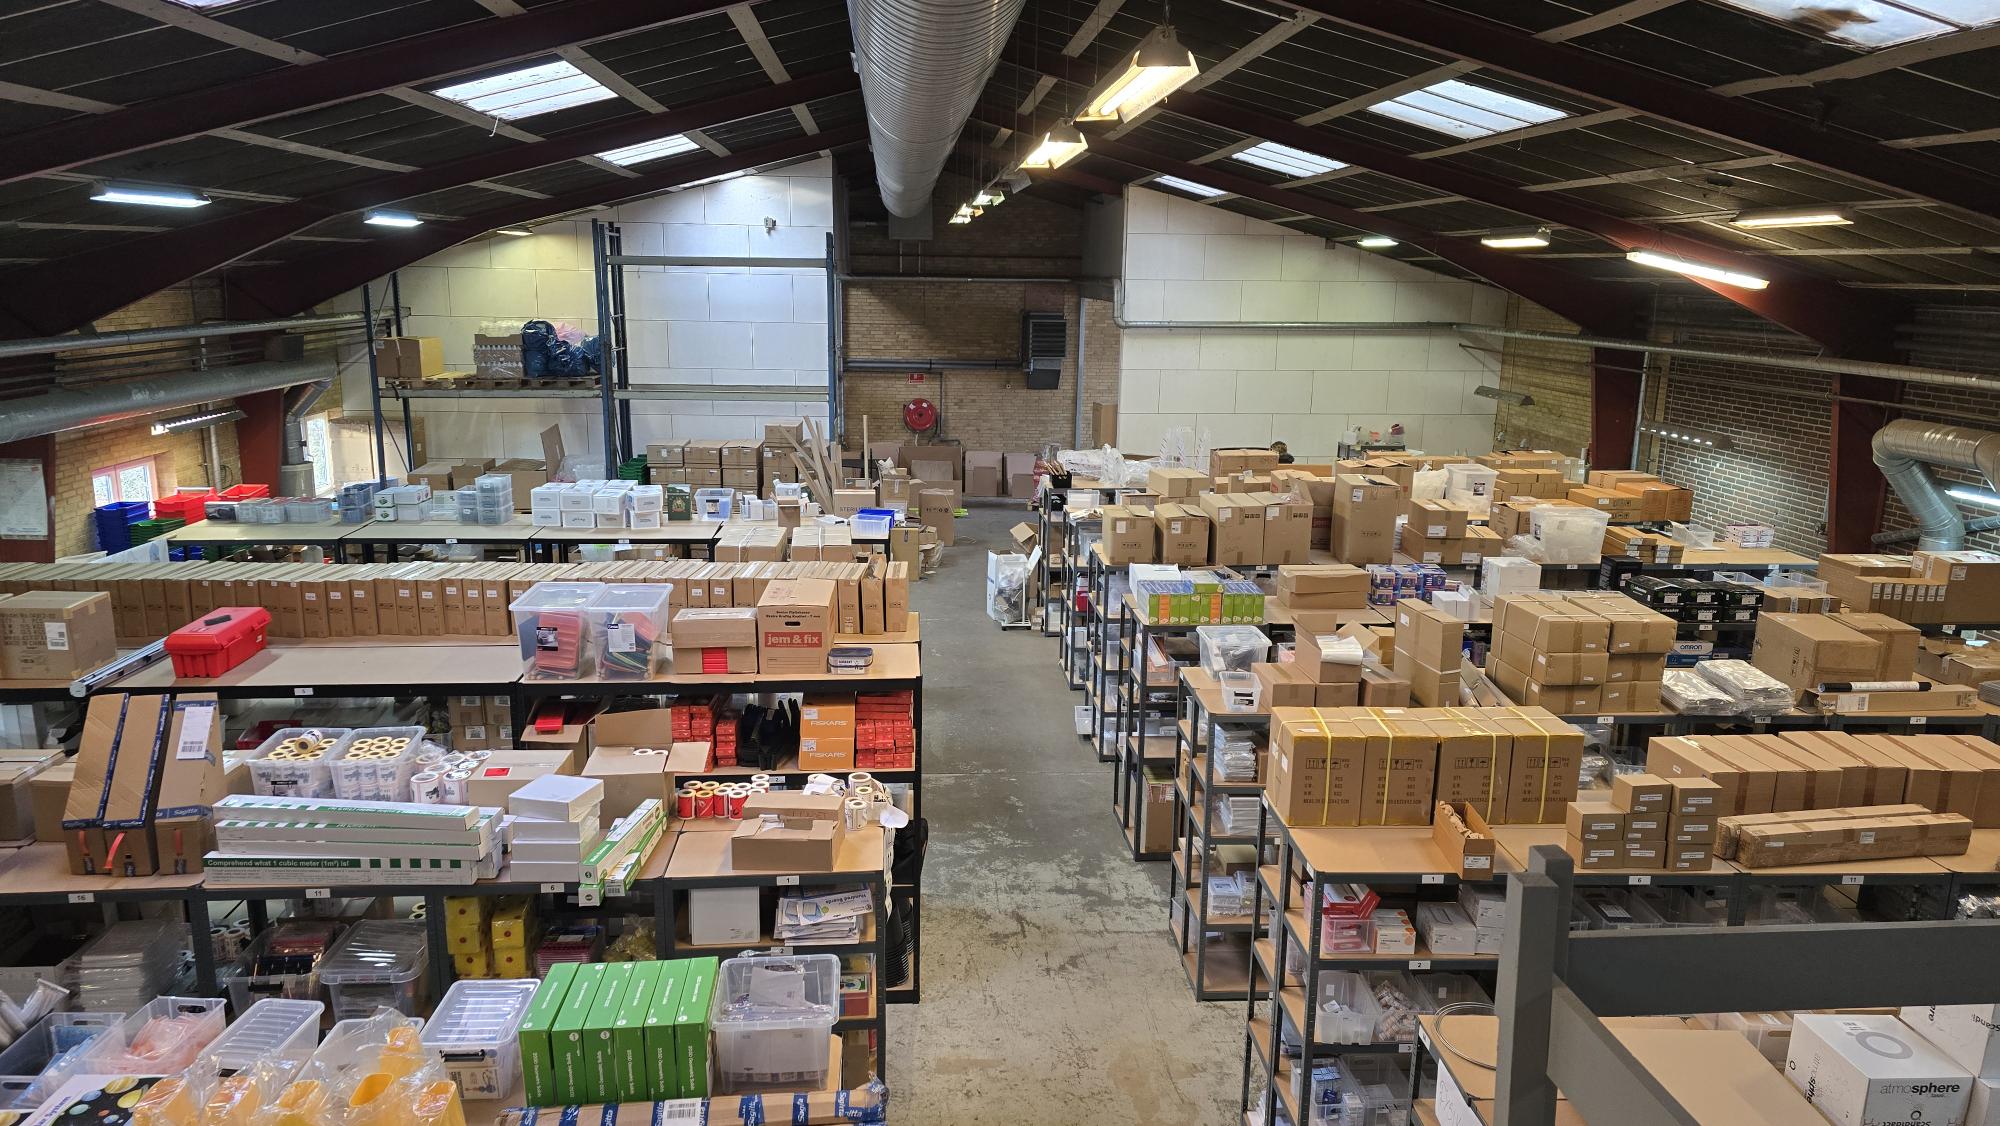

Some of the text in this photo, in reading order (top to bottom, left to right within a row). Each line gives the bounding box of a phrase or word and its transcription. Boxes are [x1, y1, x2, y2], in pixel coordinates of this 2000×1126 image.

[767, 634, 819, 645] jem & fix
[174, 808, 198, 816] Sagitta
[208, 860, 253, 868] Comprehend
[1880, 1082, 1960, 1095] atmosphere
[838, 1092, 846, 1117] Sagitta
